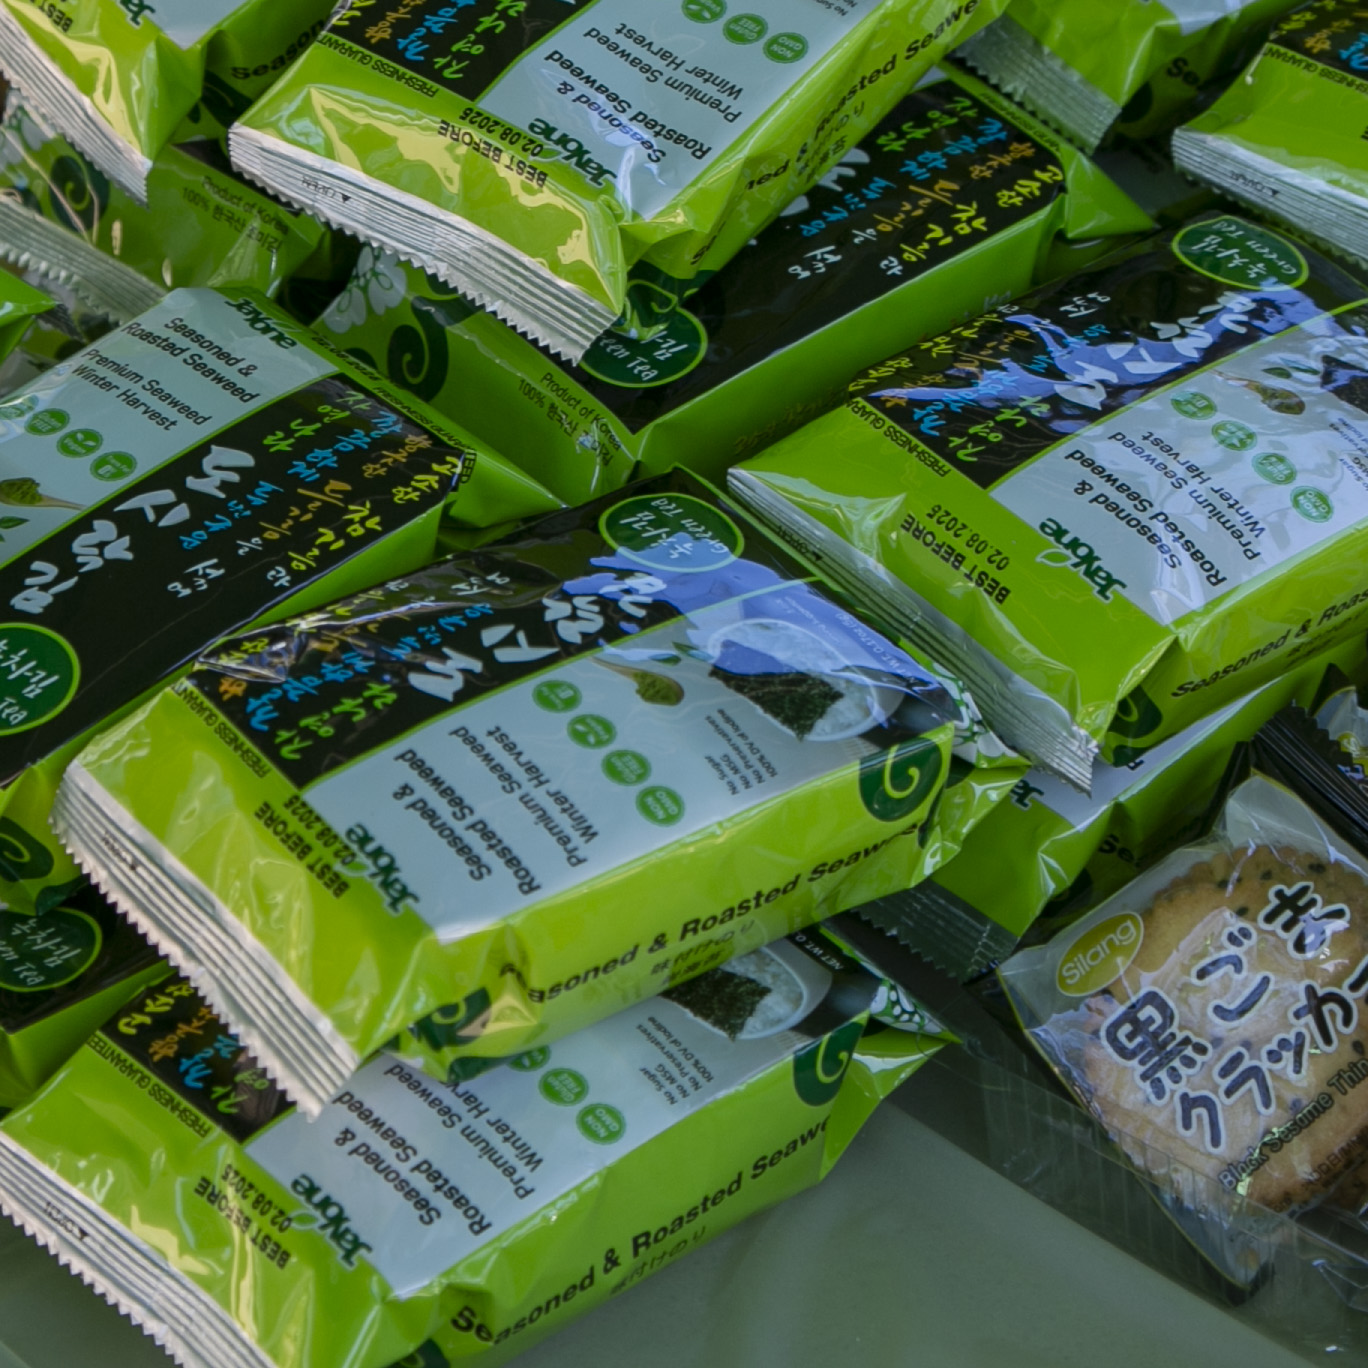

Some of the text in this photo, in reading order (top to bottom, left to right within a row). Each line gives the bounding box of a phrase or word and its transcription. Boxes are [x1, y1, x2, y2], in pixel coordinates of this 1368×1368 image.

[769, 41, 795, 59] NON
[831, 4, 849, 16] No
[369, 56, 441, 99] FRESHNESS
[578, 26, 743, 122] Premium Seaweed
[610, 22, 746, 100] Winter Harvest
[541, 48, 713, 161] Roasted Seaweed
[553, 79, 674, 164] Seasoned &
[431, 118, 552, 187] BEST BEFORE
[1188, 232, 1273, 283] 녹차김
[1211, 219, 1300, 276] Green Tea
[80, 346, 216, 426] Premium Seaweed
[120, 319, 265, 404] Roasted Seaweed
[161, 316, 260, 377] Seasoned &
[70, 363, 183, 431] Winter Harvest
[255, 383, 378, 464] 자연나라
[933, 390, 1067, 464] 자연나라
[356, 429, 437, 484] 향긋한
[384, 451, 468, 509] 고소한
[1105, 431, 1262, 560] Premium Seaweed
[1136, 430, 1269, 538] Winter Harvest
[617, 506, 697, 565] 녹차김
[648, 494, 731, 556] Green Tea
[1063, 449, 1231, 587] Roasted Seaweed
[1084, 492, 1191, 569] Seasoned
[900, 513, 1011, 604] BEST BEFORE
[389, 556, 685, 708] 도시락김
[256, 676, 415, 763] 자연나라
[391, 748, 545, 895] Roasted Seaweed
[442, 726, 591, 867] Premium Seaweed
[478, 725, 602, 843] Winter Harvest
[246, 801, 355, 898] BEST BEFORE
[399, 796, 499, 881] Seasoned
[677, 870, 803, 950] Roasted
[12, 955, 47, 991] Tea
[1060, 918, 1139, 987] Silang
[328, 1089, 497, 1237] Roasted Seaweed
[381, 1062, 538, 1199] Premium Seaweed
[477, 1114, 548, 1172] Winter
[1218, 1141, 1266, 1191] Black
[1269, 1086, 1343, 1150] Sesame
[343, 1140, 446, 1227] Seasoned
[243, 1226, 297, 1269] BEST
